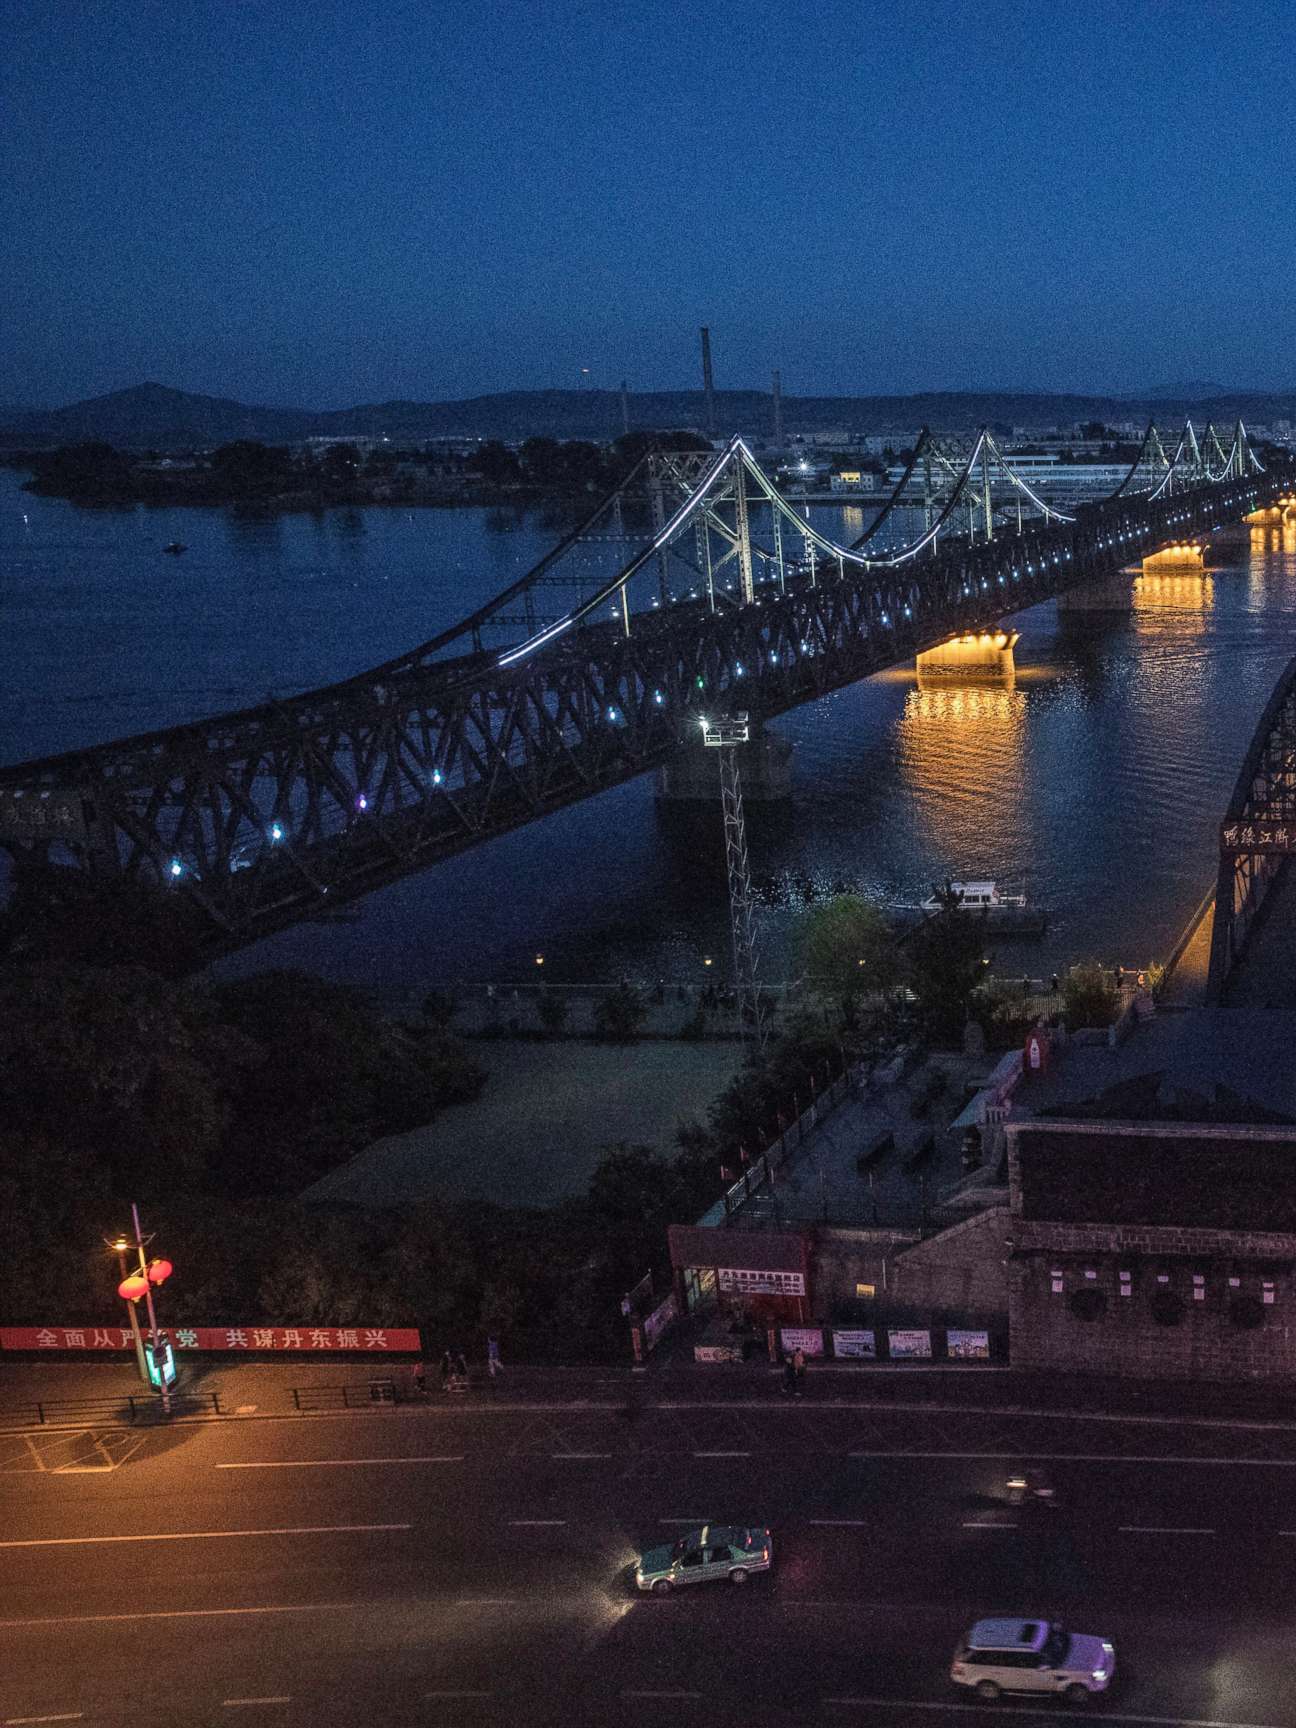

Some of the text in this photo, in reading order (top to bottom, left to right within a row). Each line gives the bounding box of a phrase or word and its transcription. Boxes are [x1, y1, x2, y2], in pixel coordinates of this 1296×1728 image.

[226, 1328, 388, 1348] 共谋丹东振兴
